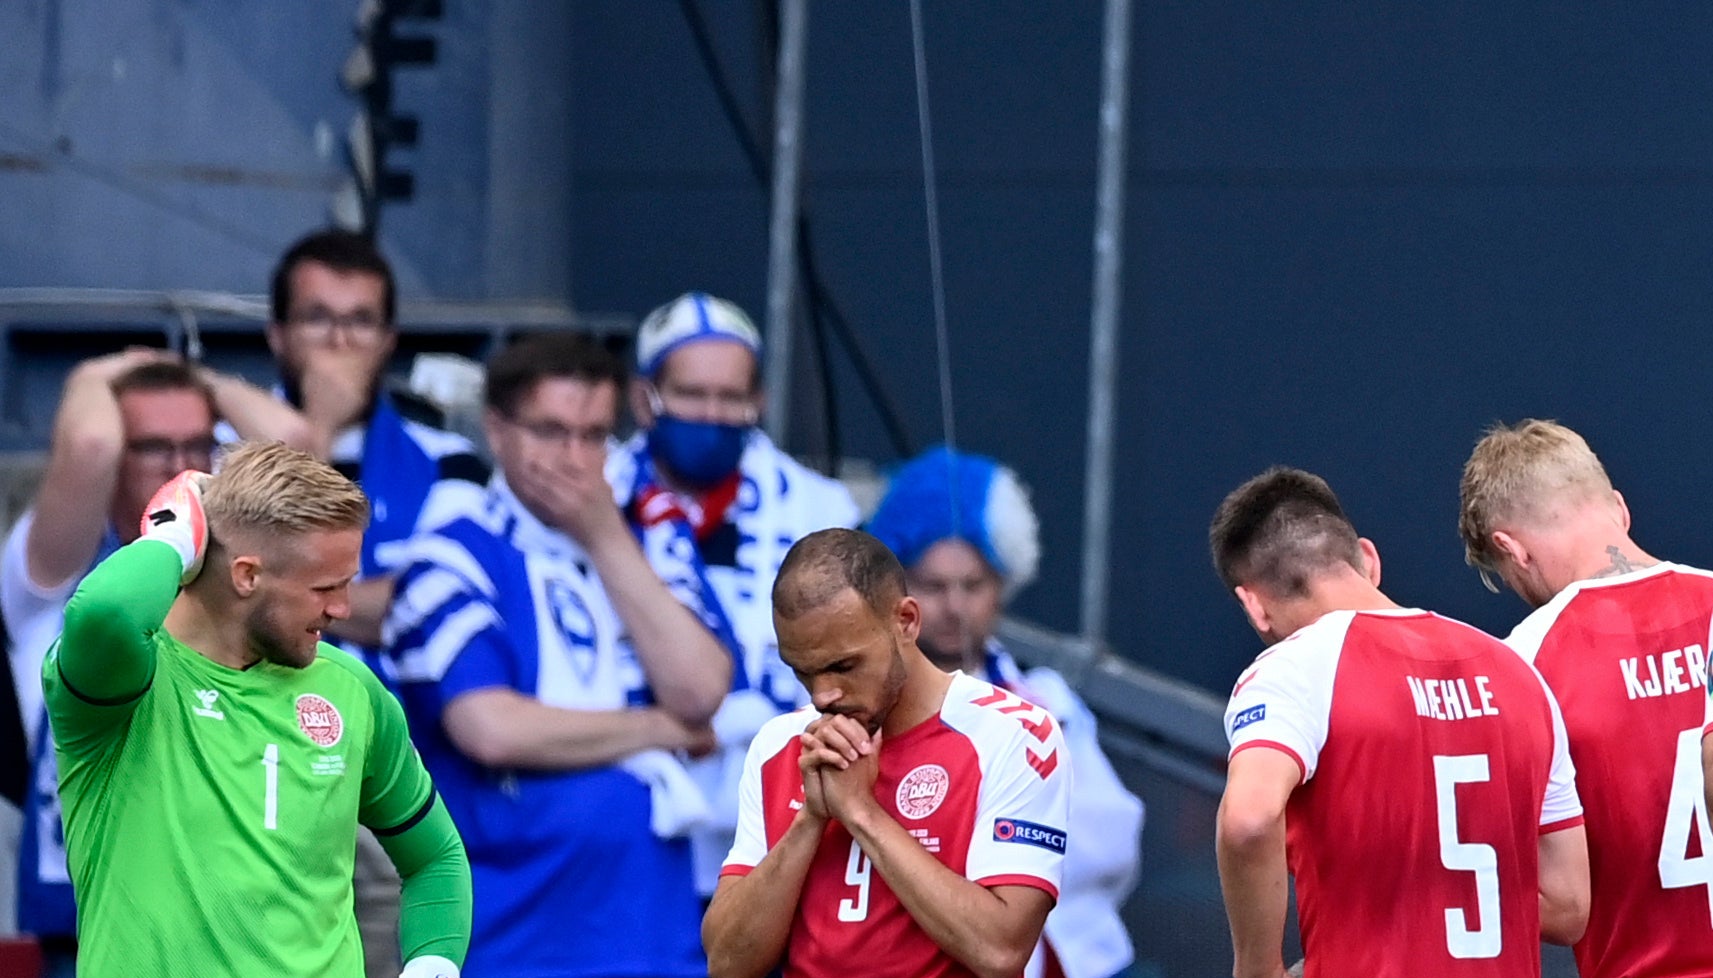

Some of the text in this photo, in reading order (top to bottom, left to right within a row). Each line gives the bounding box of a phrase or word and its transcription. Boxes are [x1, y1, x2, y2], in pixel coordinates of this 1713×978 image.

[302, 711, 331, 727] DBU
[1406, 675, 1499, 720] MÆHLE
[261, 744, 279, 829] 1
[909, 782, 938, 799] DBU
[1016, 826, 1065, 848] RESPECT
[1433, 754, 1502, 959] 5
[838, 837, 871, 923] 9
